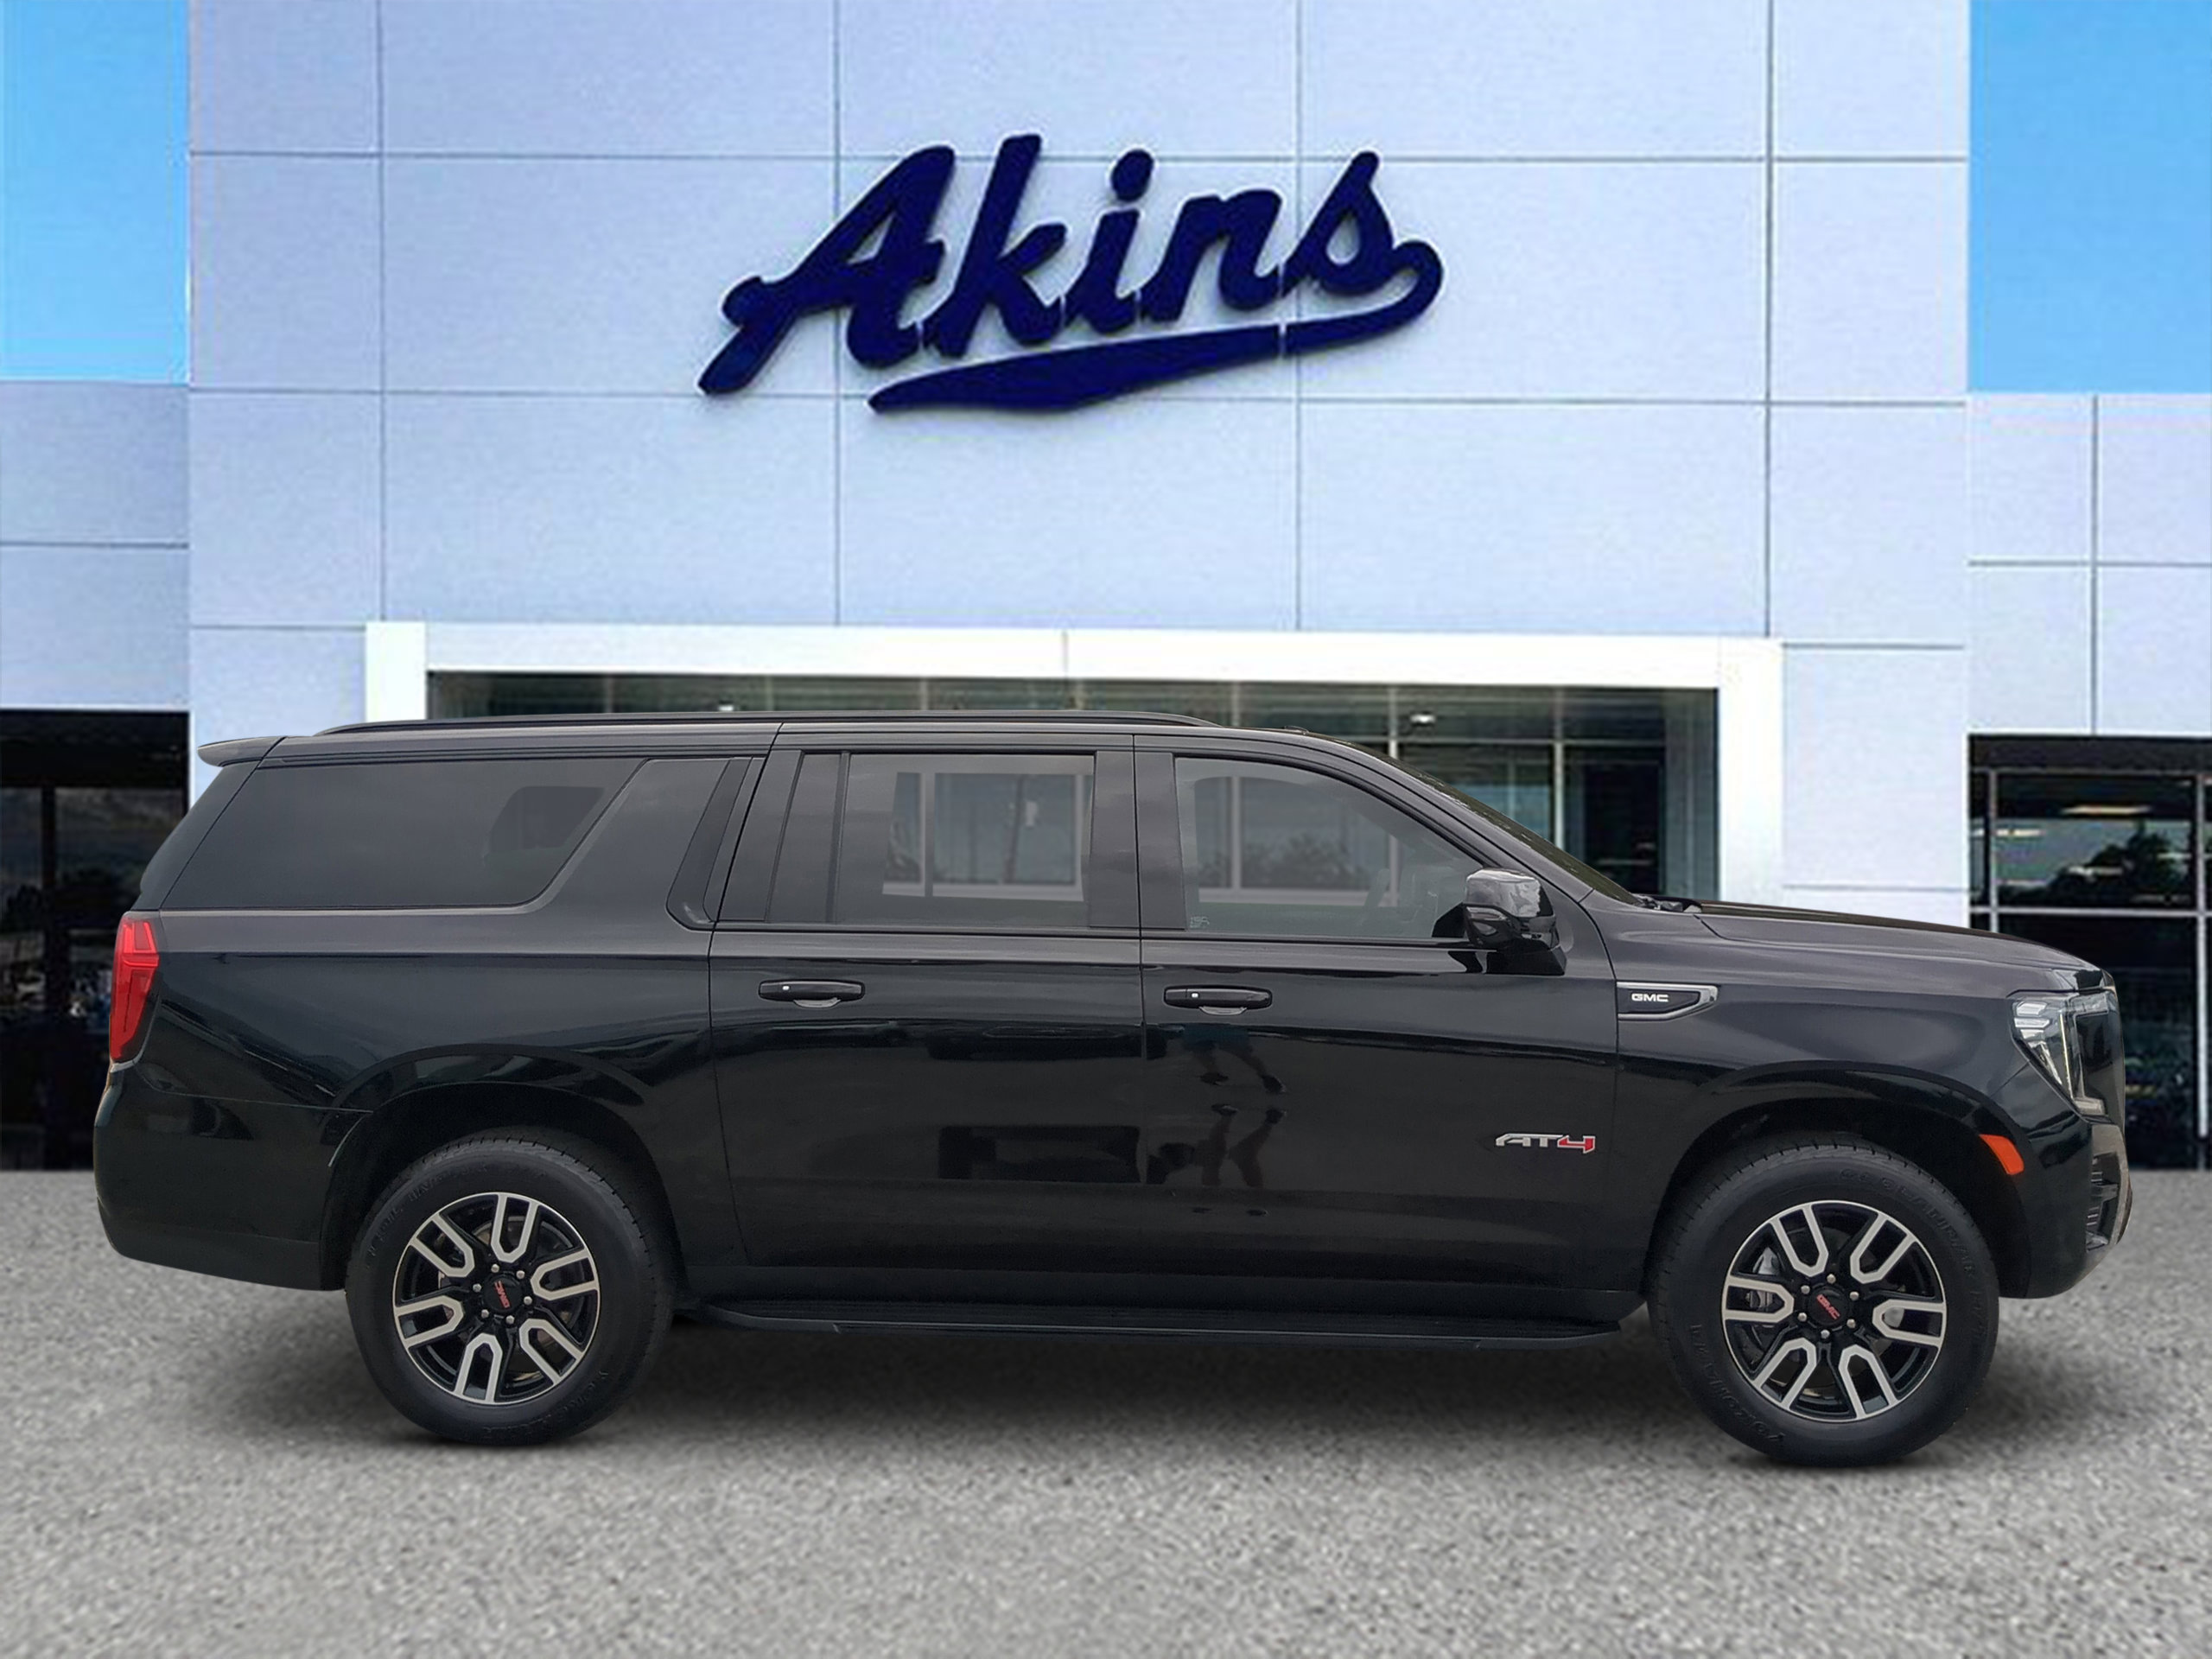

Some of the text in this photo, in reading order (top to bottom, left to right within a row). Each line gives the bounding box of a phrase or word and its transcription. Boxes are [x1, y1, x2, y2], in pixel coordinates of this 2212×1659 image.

[697, 134, 1444, 415] Akins
[1630, 993, 1669, 1002] GMC
[1495, 1133, 1596, 1154] AT4
[1816, 1294, 1840, 1319] GMC
